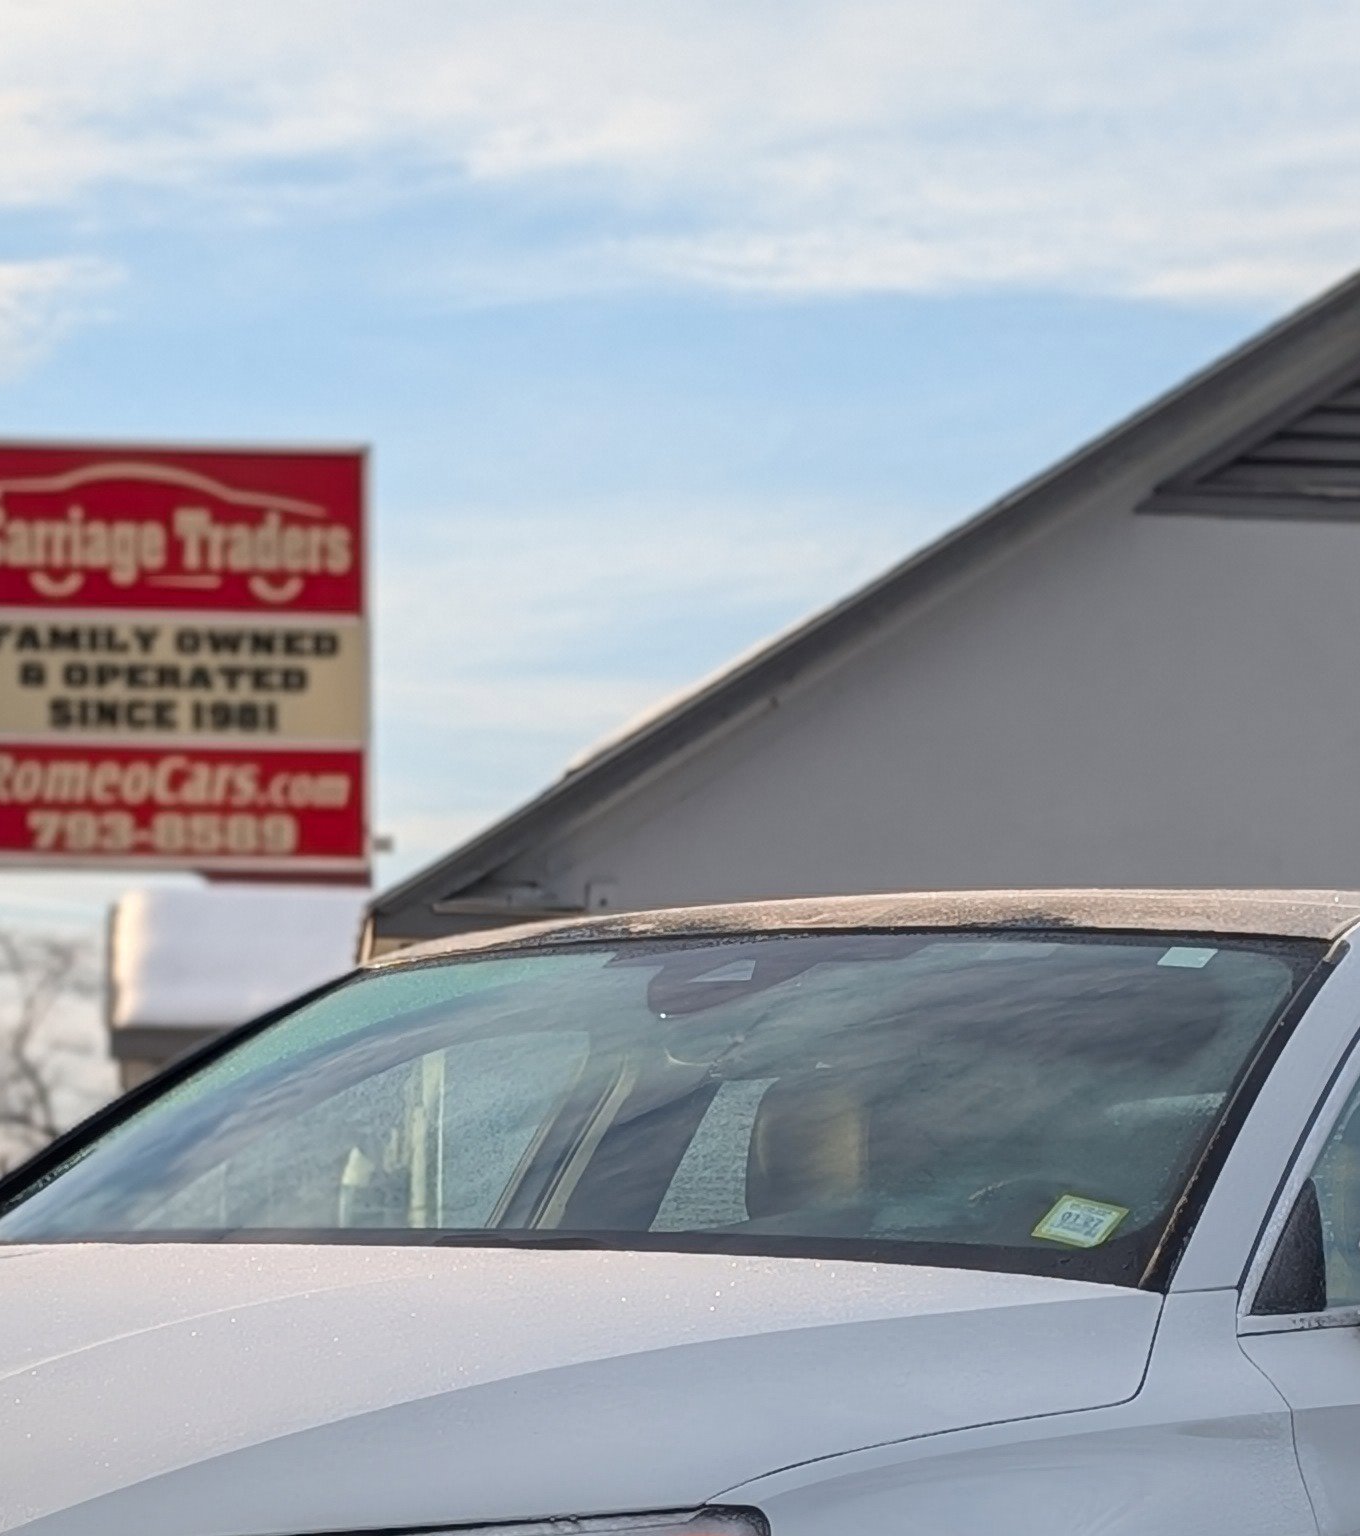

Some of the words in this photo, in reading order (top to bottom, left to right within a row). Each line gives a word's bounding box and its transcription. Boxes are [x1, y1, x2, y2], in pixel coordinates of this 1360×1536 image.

[172, 507, 352, 575] Traders
[175, 628, 339, 658] OWNED
[62, 663, 308, 692] OPERATED
[48, 699, 178, 731] SINCE
